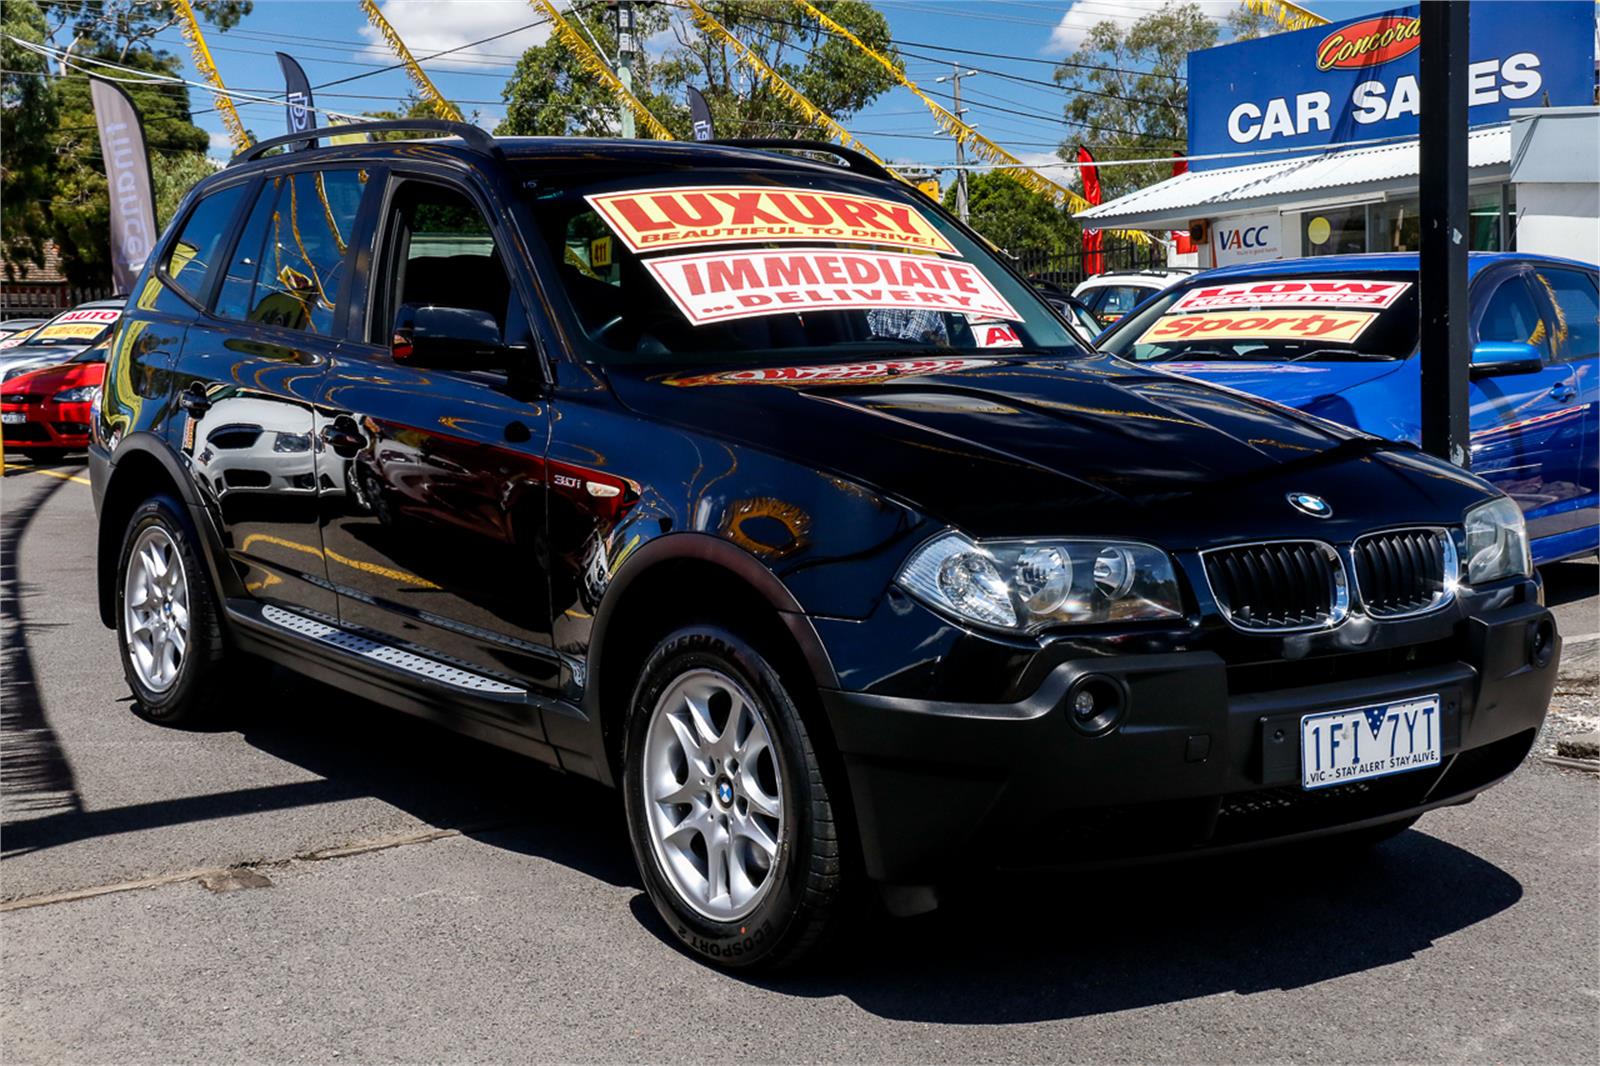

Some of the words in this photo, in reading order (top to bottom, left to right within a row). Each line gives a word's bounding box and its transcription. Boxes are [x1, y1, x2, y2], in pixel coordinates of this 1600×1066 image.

[1227, 91, 1331, 143] CAR
[1352, 52, 1542, 124] SAES
[610, 193, 921, 236] LUXURY
[640, 226, 805, 243] BEAUTIFUL
[812, 227, 845, 235] TO
[851, 230, 935, 246] DRIVE!
[1219, 225, 1269, 250] VACC
[681, 256, 981, 297] IMMEDIATE
[1195, 284, 1394, 298] LOW
[63, 311, 118, 321] AUTO
[1154, 315, 1359, 337] Sporty
[1310, 770, 1326, 783] VIC
[1335, 765, 1358, 778] STAY
[1359, 759, 1385, 774] ALERT
[1389, 756, 1409, 768] STAY
